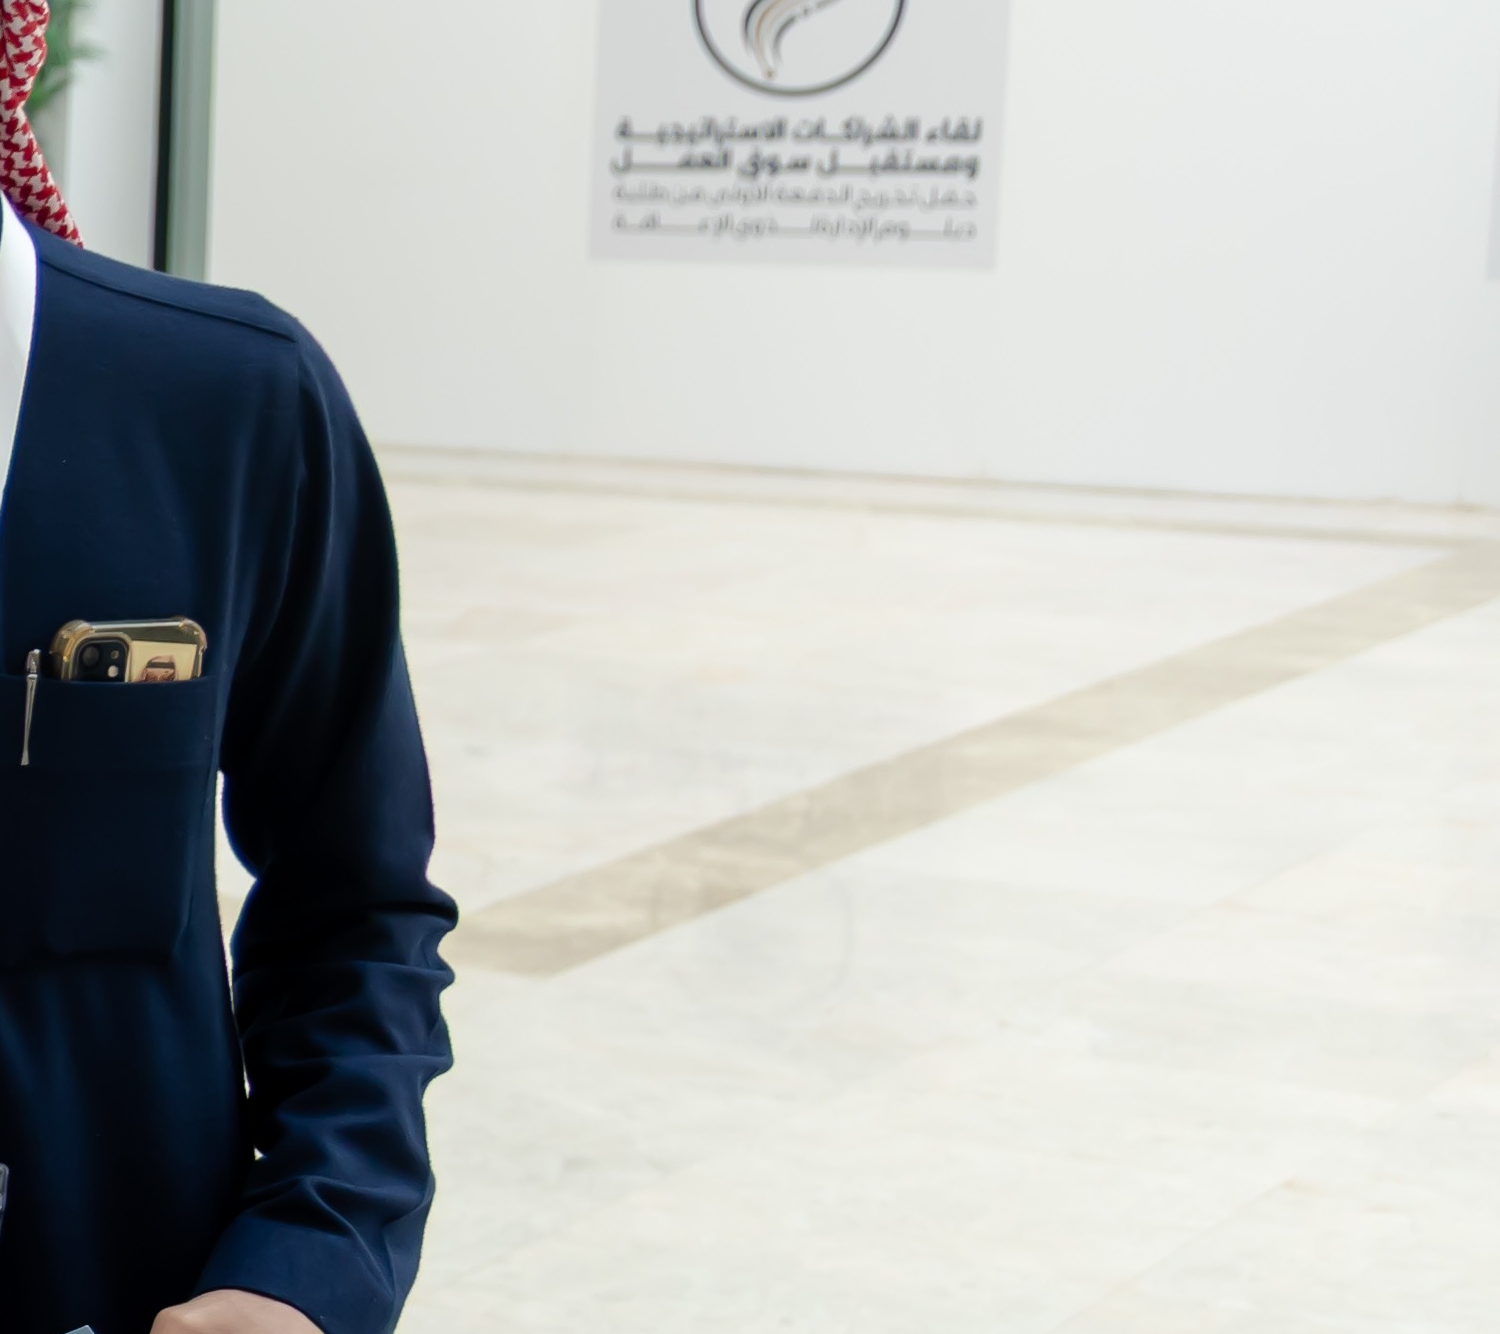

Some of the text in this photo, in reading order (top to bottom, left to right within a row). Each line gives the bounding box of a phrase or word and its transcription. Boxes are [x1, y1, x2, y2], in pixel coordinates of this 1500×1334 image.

[614, 115, 982, 147] لقاء الشراكات الاستراتيجية
[610, 147, 982, 181] ومستقبل سوق العمل
